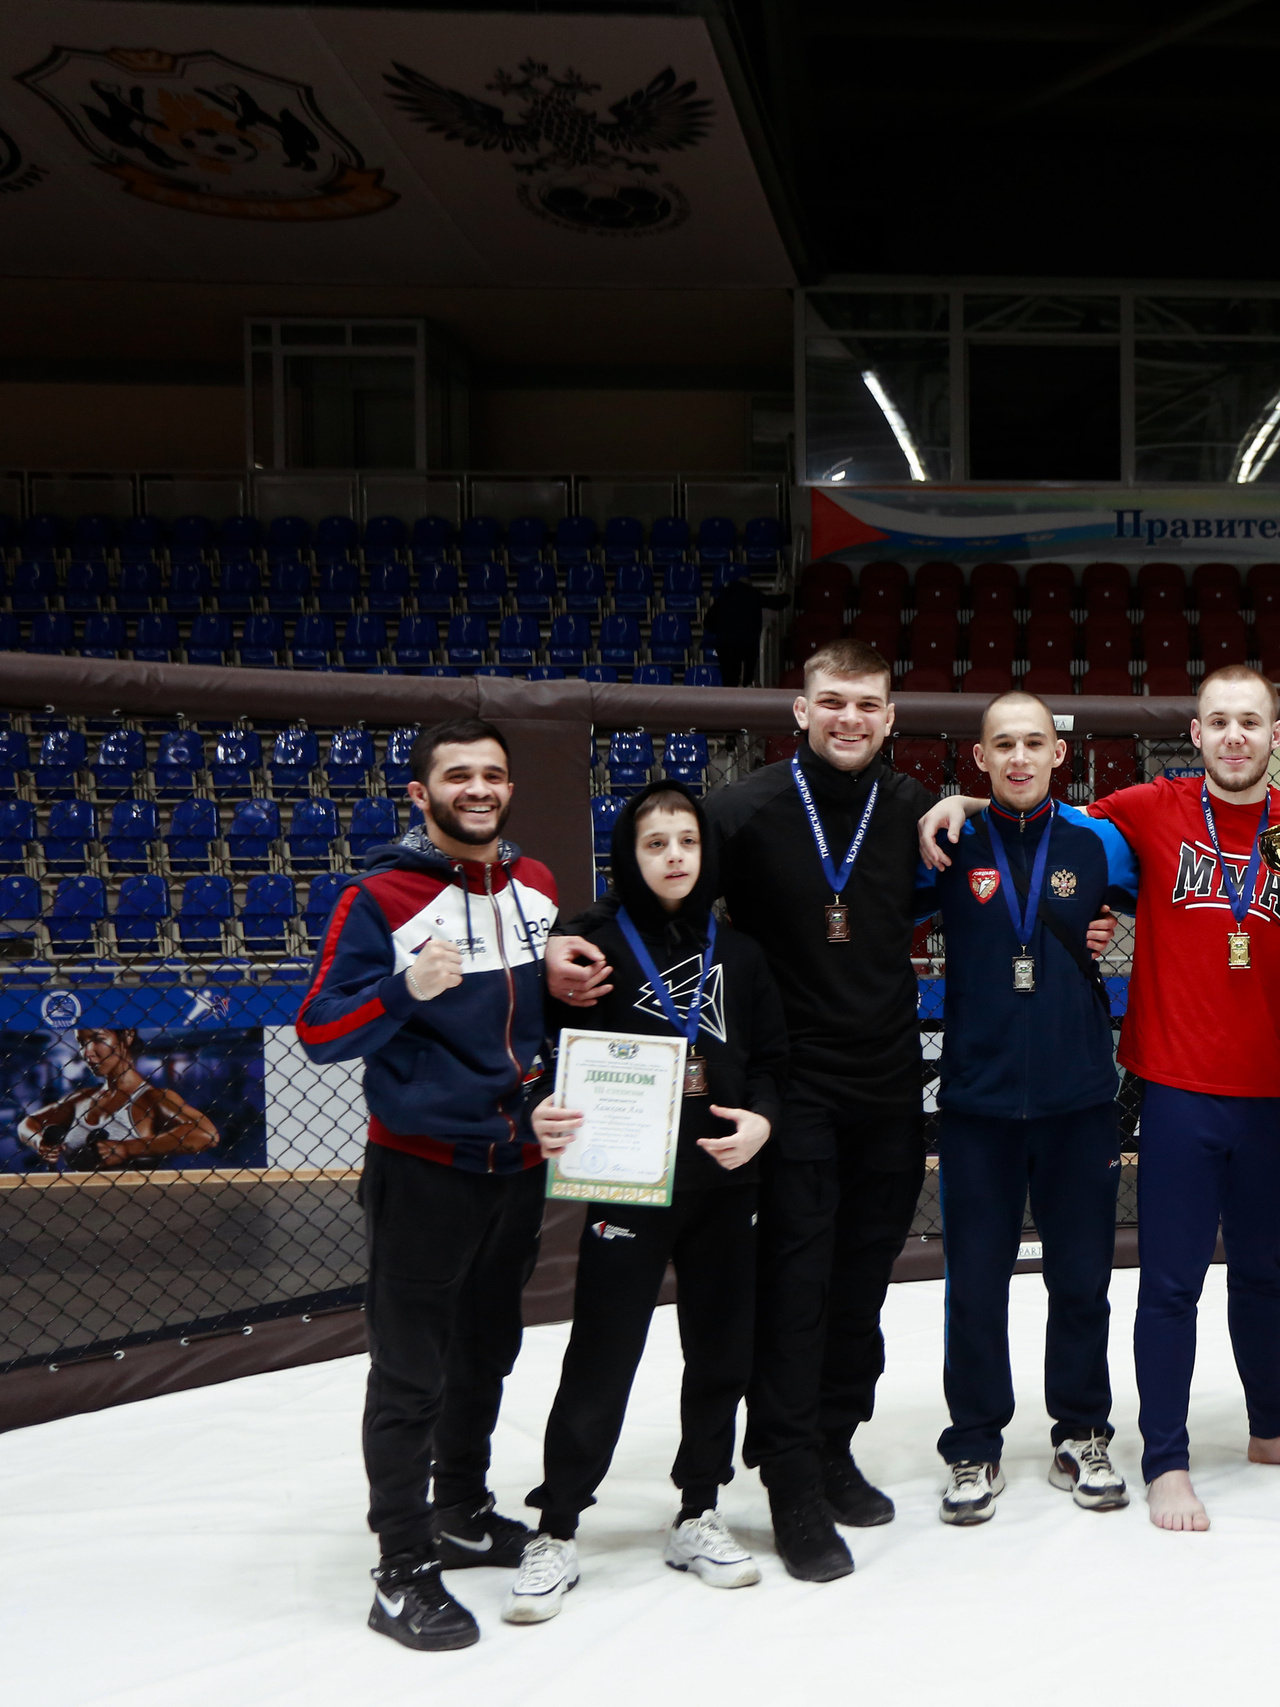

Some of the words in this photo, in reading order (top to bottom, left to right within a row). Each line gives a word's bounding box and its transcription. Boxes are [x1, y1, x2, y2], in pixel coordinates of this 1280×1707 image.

[795, 769, 812, 804] ОБЛАСТЬ
[806, 804, 830, 859] ТЮМЕНСКАЯ
[584, 1069, 657, 1086] ДИПЛОМ
